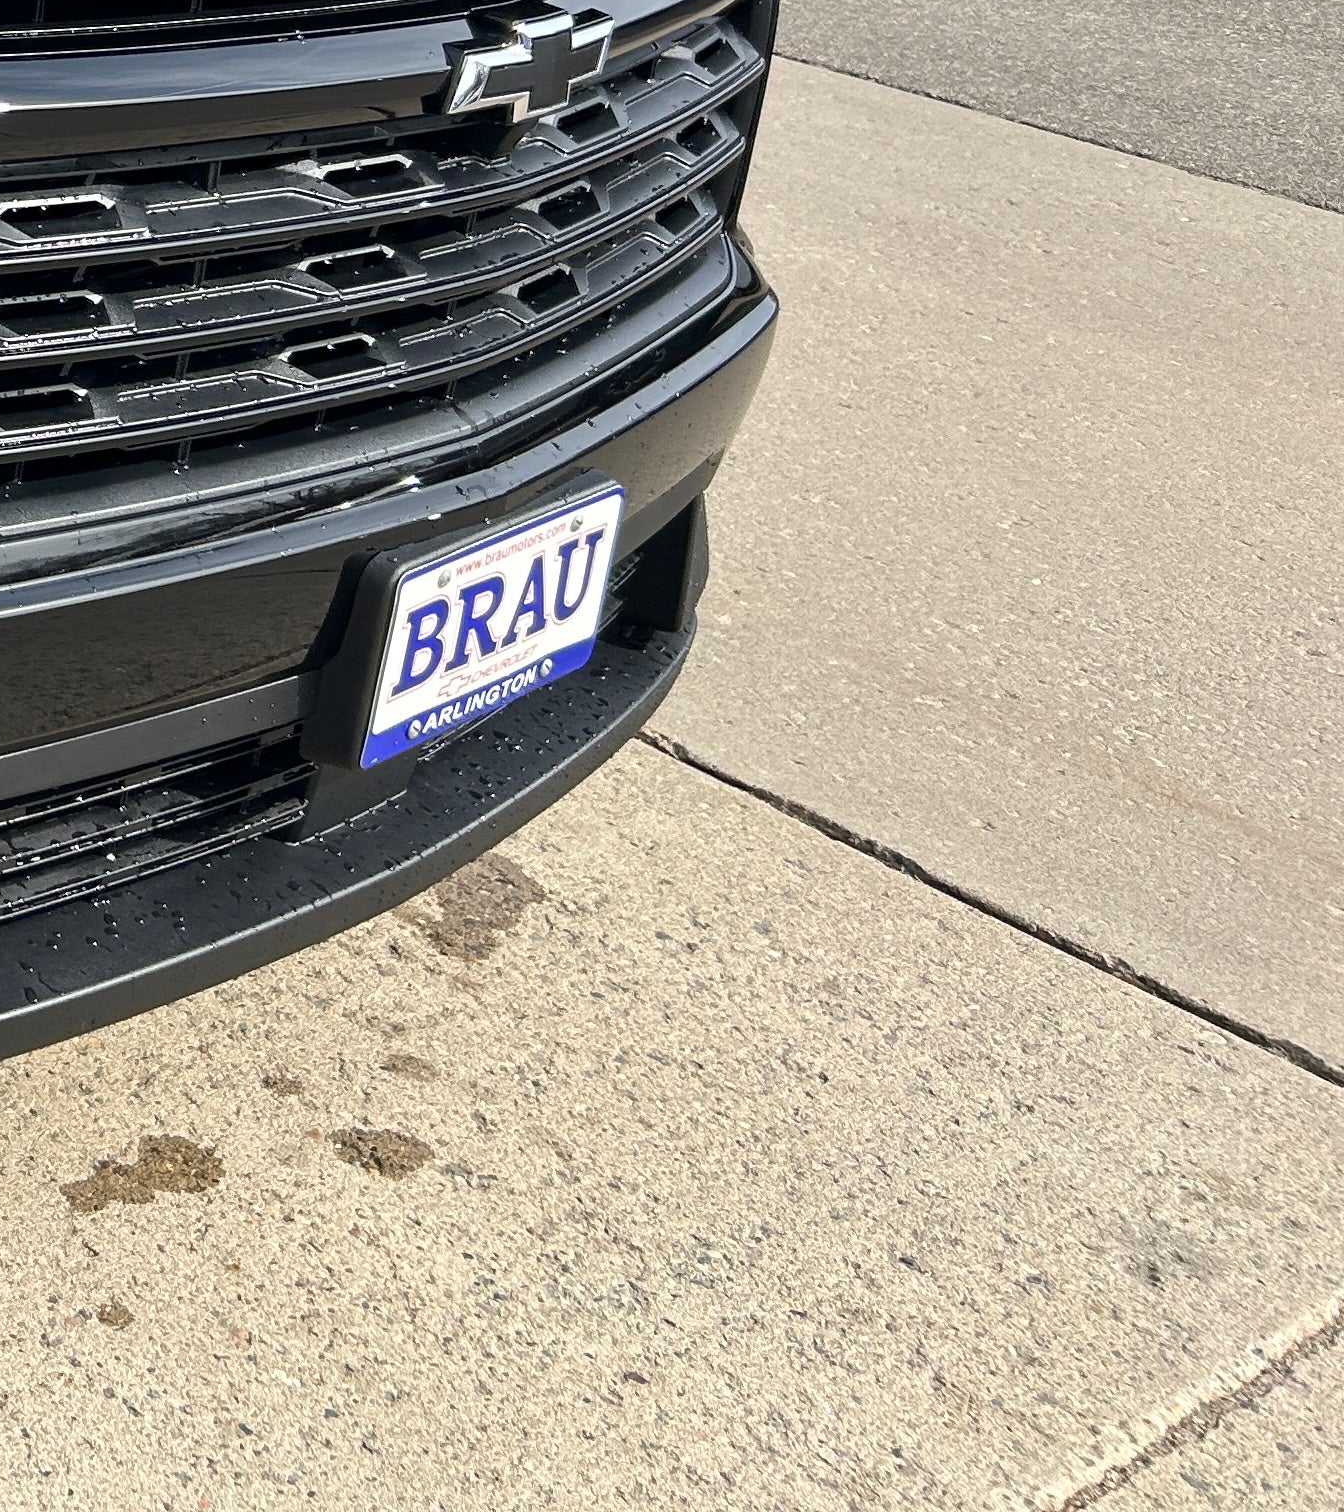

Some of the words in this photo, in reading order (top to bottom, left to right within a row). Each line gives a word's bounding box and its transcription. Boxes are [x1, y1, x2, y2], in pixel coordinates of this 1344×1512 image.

[455, 521, 567, 577] www.braumotors.com
[388, 524, 607, 700] BRAU
[421, 664, 538, 734] ARLINGTON
